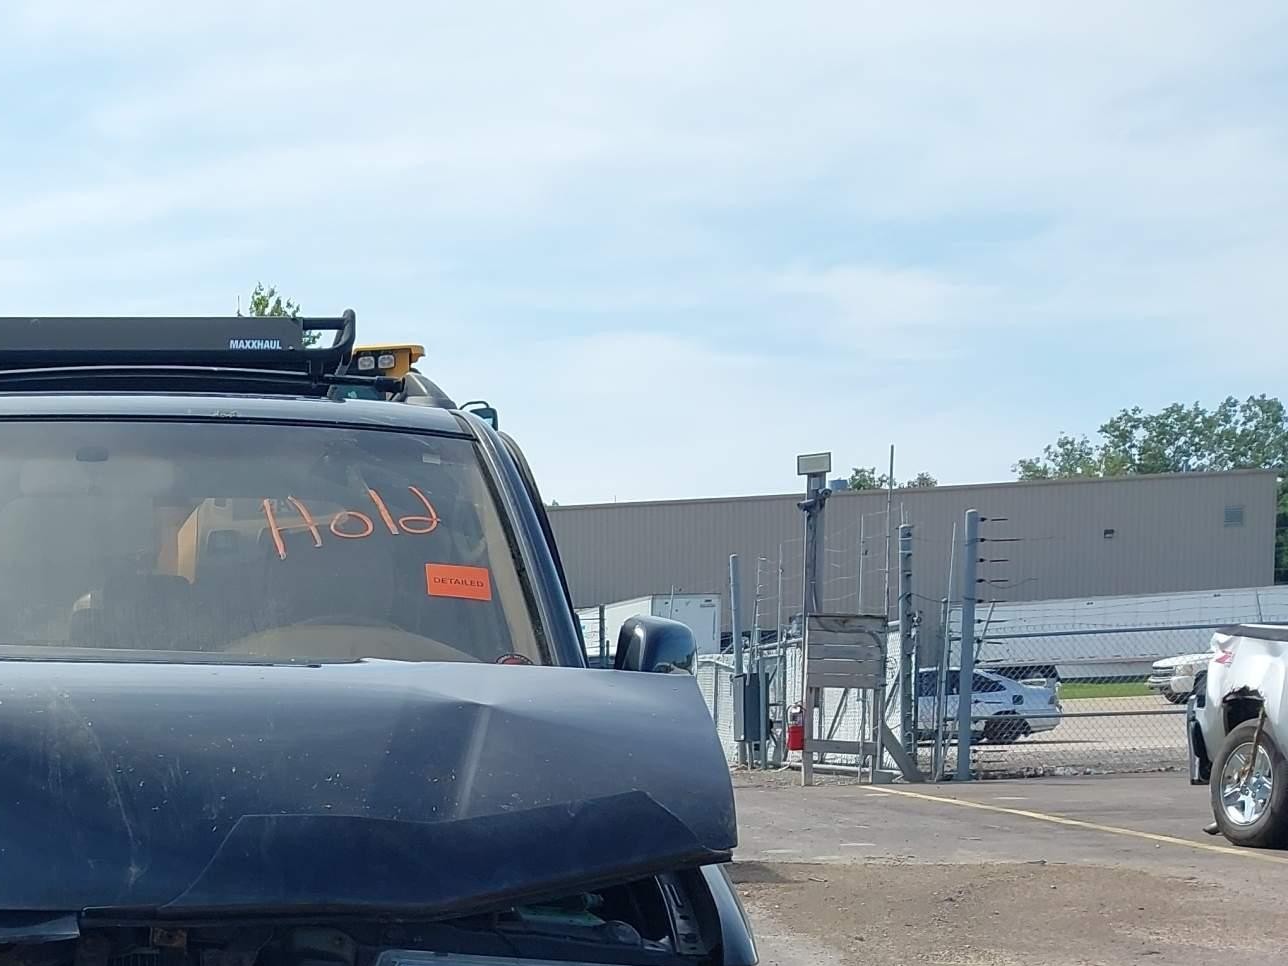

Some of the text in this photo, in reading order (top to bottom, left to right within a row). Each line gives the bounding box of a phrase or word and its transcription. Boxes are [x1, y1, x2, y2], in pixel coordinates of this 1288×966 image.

[229, 339, 282, 350] MAXXHAUL
[263, 485, 441, 560] Hold
[433, 576, 484, 588] DETAILED
